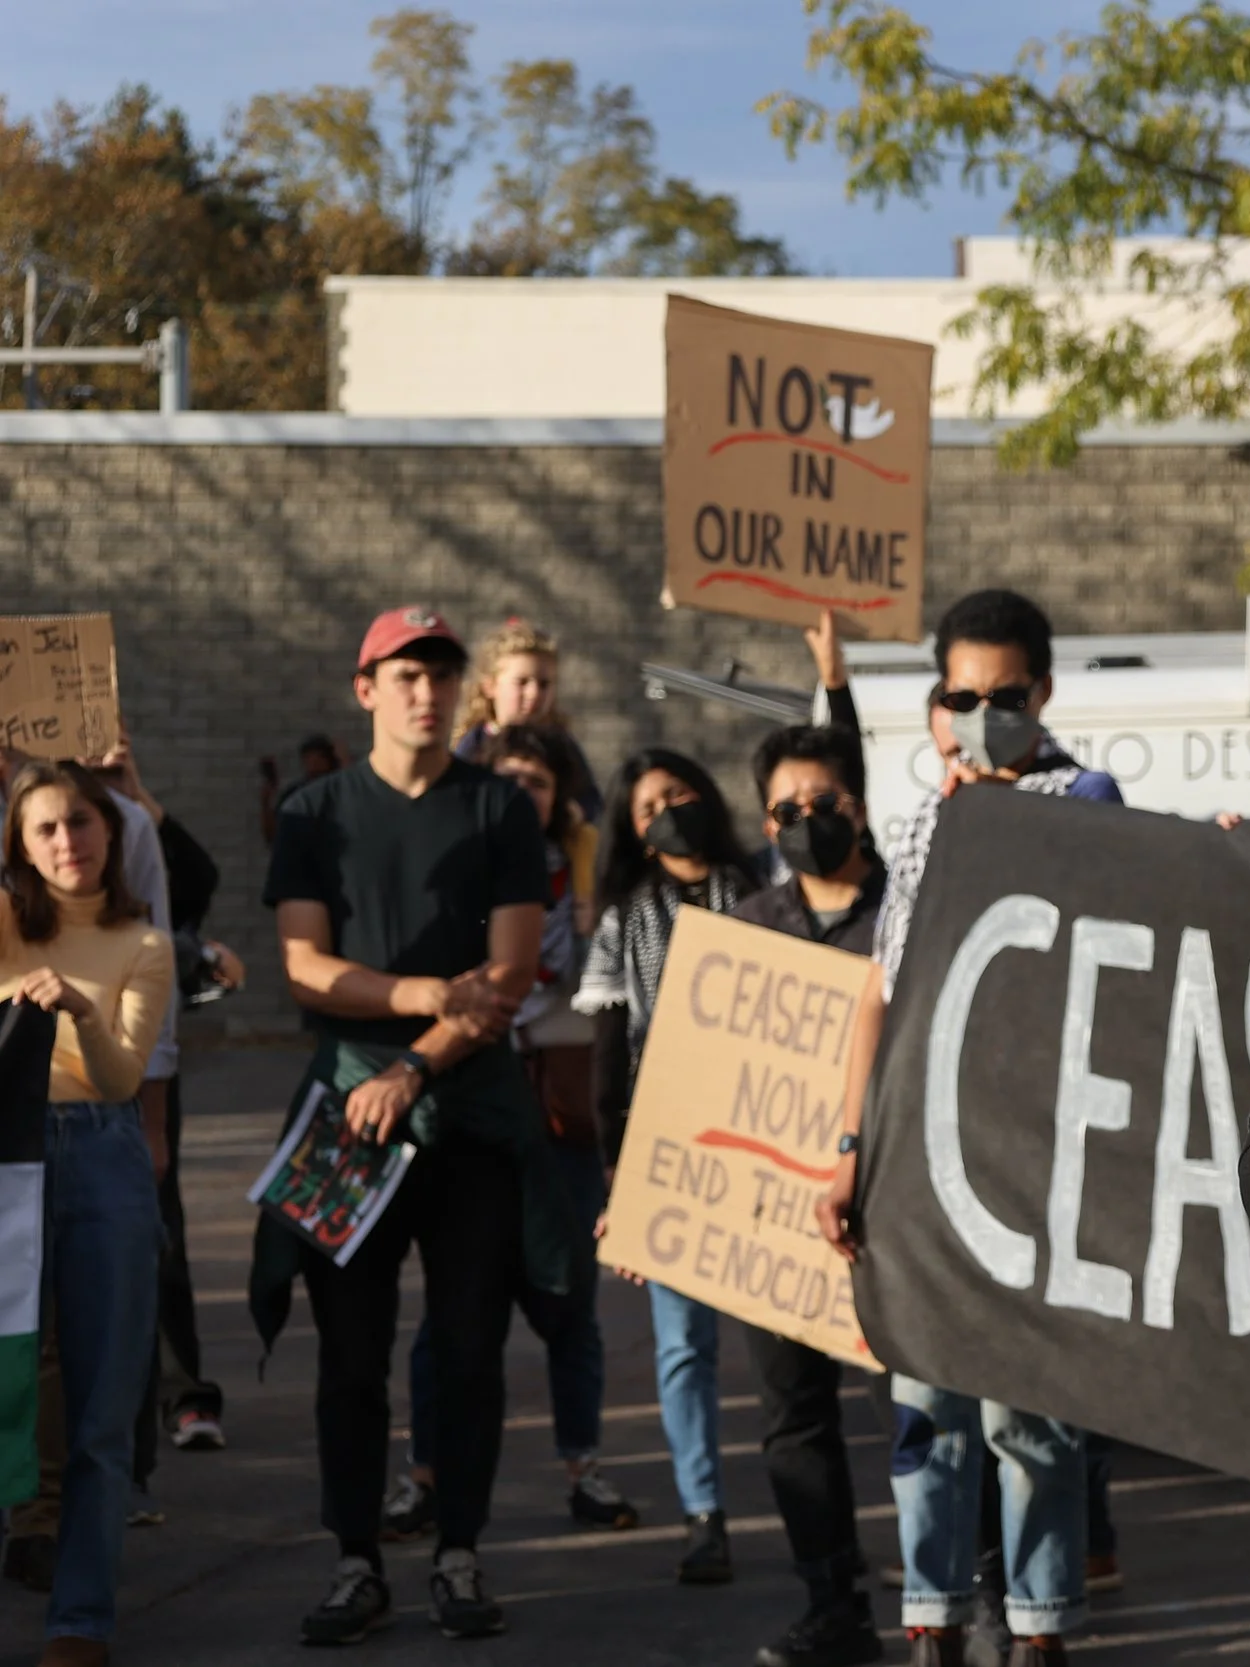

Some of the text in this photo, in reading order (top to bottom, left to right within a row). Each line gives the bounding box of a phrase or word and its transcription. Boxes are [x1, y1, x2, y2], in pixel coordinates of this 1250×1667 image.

[727, 352, 873, 444] NOT
[790, 451, 836, 502] IN
[694, 502, 909, 591] OUR NAME
[729, 1059, 845, 1154] NOW
[645, 1136, 730, 1207] END
[645, 1206, 856, 1329] GENOCIDE
